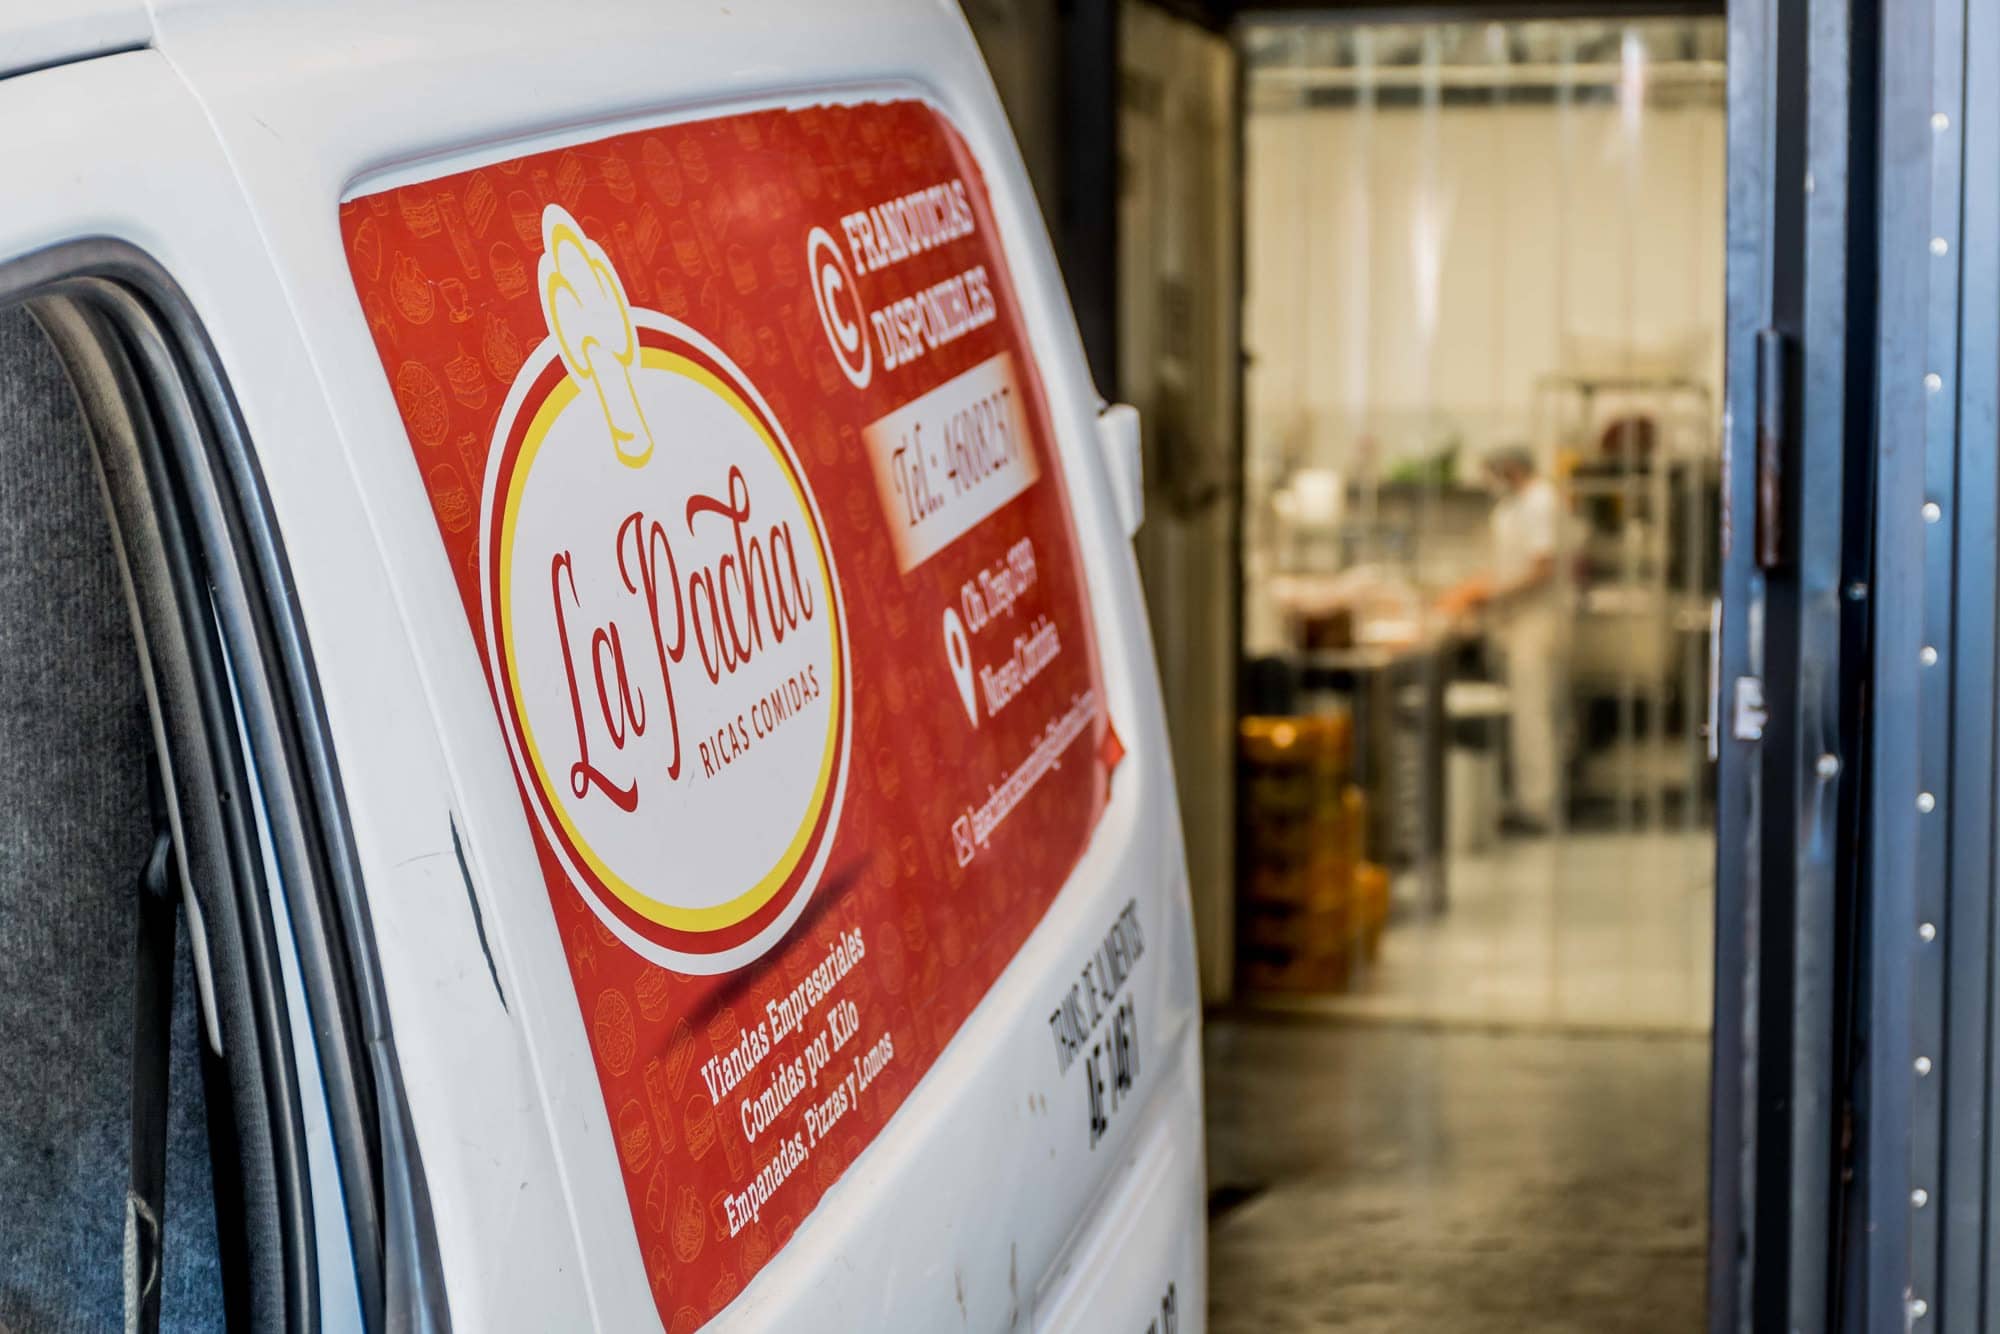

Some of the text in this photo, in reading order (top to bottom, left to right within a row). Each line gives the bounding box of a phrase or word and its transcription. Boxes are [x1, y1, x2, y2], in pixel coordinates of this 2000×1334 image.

[870, 265, 996, 371] DISPONIBLES
[551, 550, 646, 813] La
[616, 464, 813, 781] Pacha
[699, 664, 821, 779] RICAS COMIDAS
[700, 926, 866, 1106] Viandas Empresariales
[740, 998, 860, 1144] Comidas por Kilo
[723, 1031, 894, 1239] Empanadas, Pizzas y Lomos
